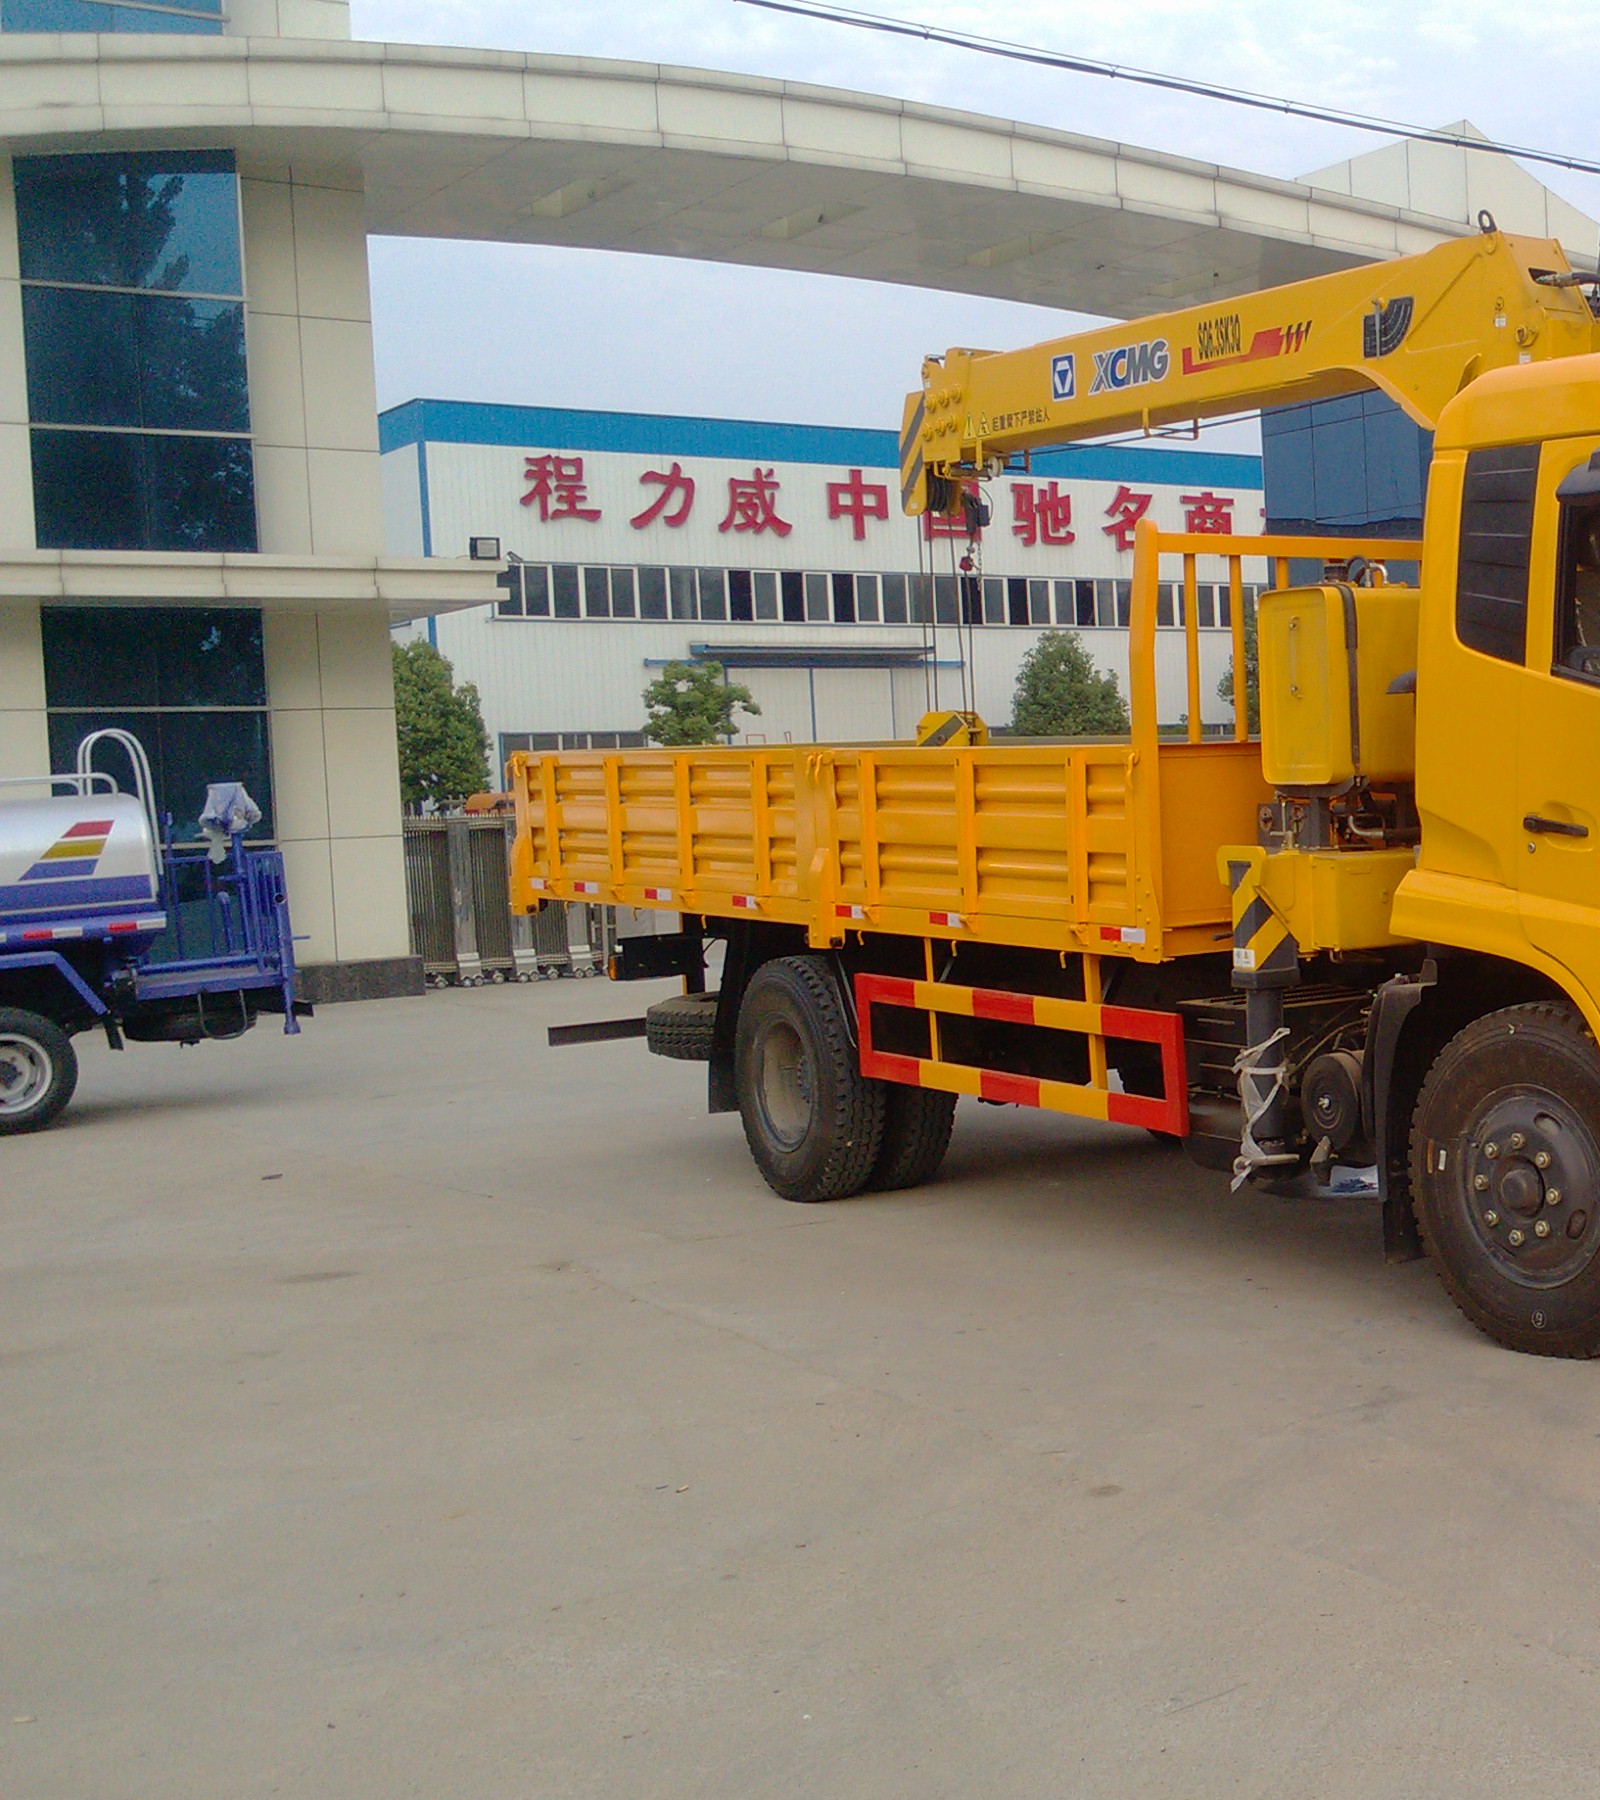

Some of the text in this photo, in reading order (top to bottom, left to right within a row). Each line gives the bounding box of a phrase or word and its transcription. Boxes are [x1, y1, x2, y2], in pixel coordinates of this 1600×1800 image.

[1090, 340, 1168, 395] XCMG
[520, 455, 1266, 551] 程力威中驰名商
